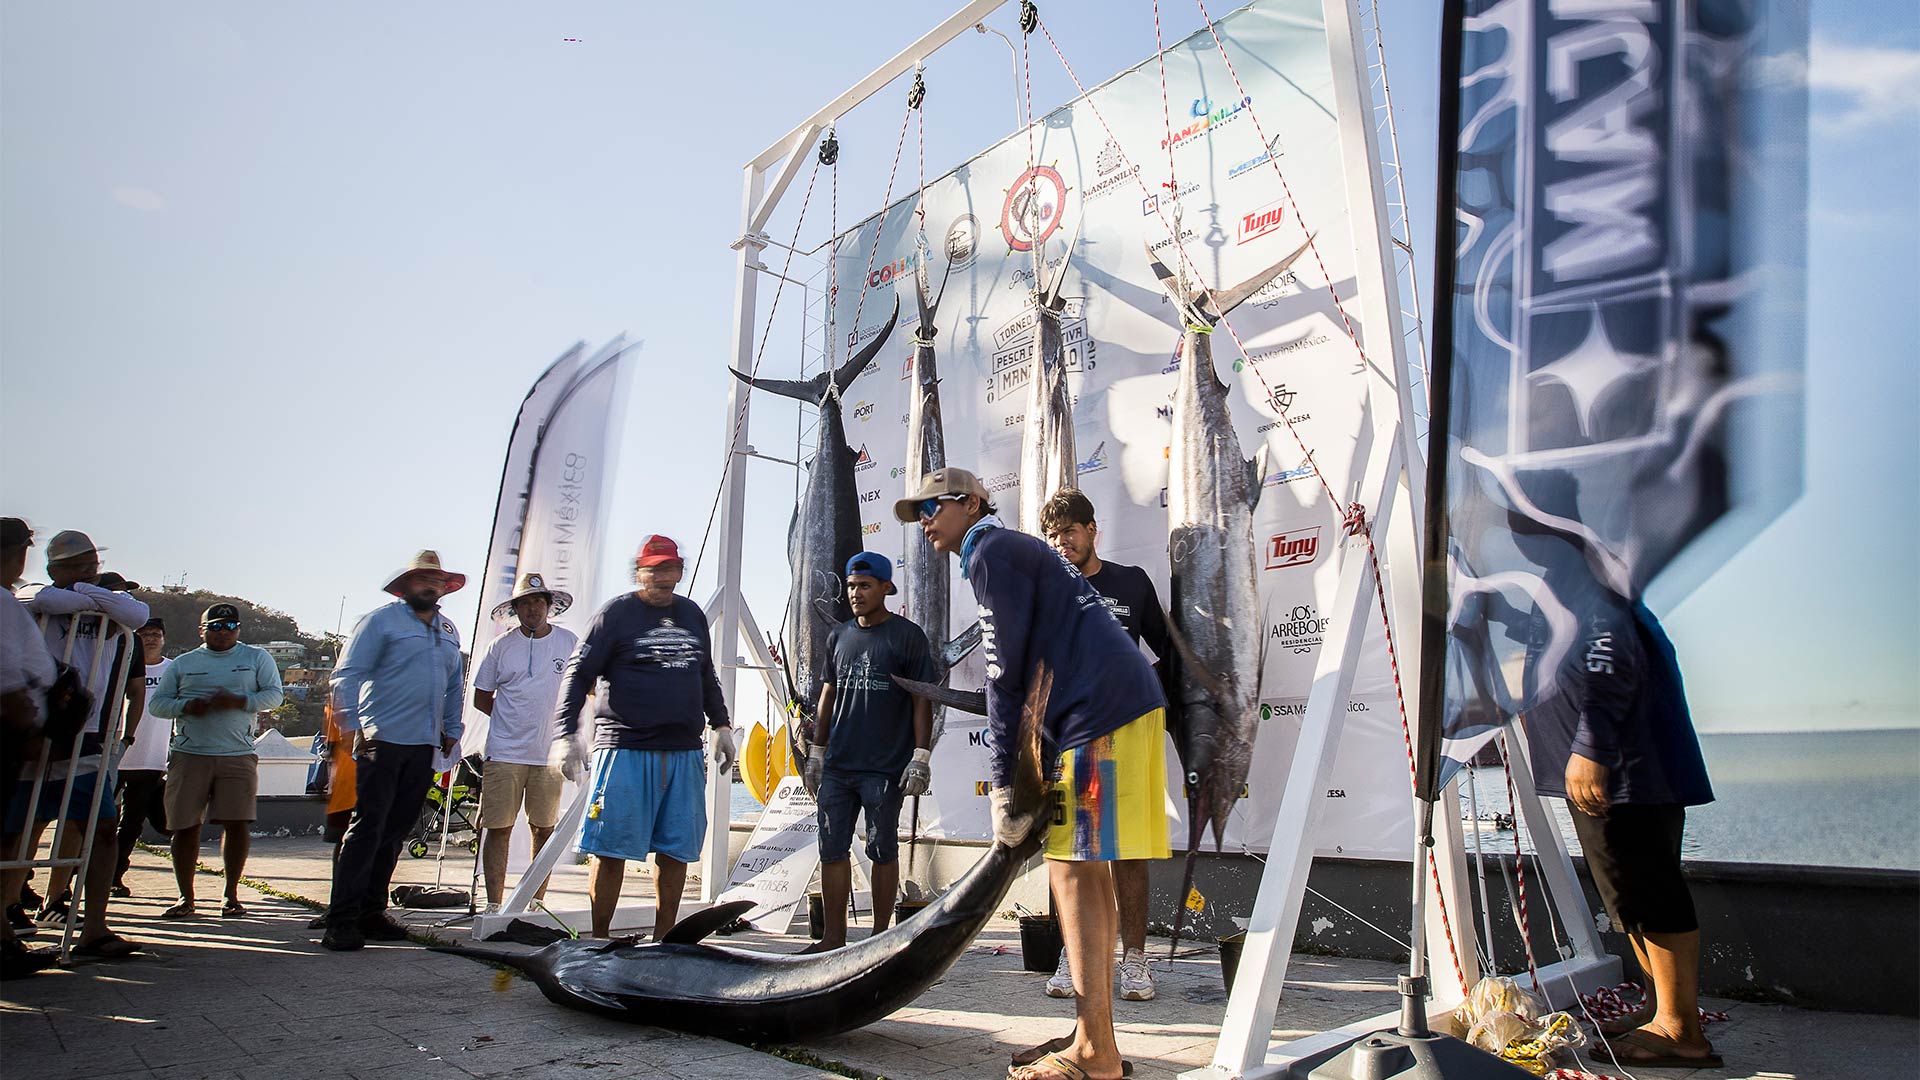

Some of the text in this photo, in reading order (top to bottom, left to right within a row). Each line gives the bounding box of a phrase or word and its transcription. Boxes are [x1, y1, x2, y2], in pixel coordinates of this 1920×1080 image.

[1161, 96, 1252, 150] MANZANILLO
[1082, 164, 1140, 198] MANZANILLO
[1243, 207, 1283, 233] Tuny
[1150, 229, 1193, 251] ARREDA
[1000, 315, 1032, 342] TORNEO
[997, 349, 1026, 369] PESCA
[1257, 421, 1281, 433] GRUPO
[986, 473, 1018, 486] LOGISTICA
[860, 489, 881, 504] NEX
[1271, 535, 1317, 557] Tuny
[1291, 605, 1311, 621] LOS
[1281, 637, 1323, 646] RESIDENCIAL
[841, 675, 879, 691] adidas
